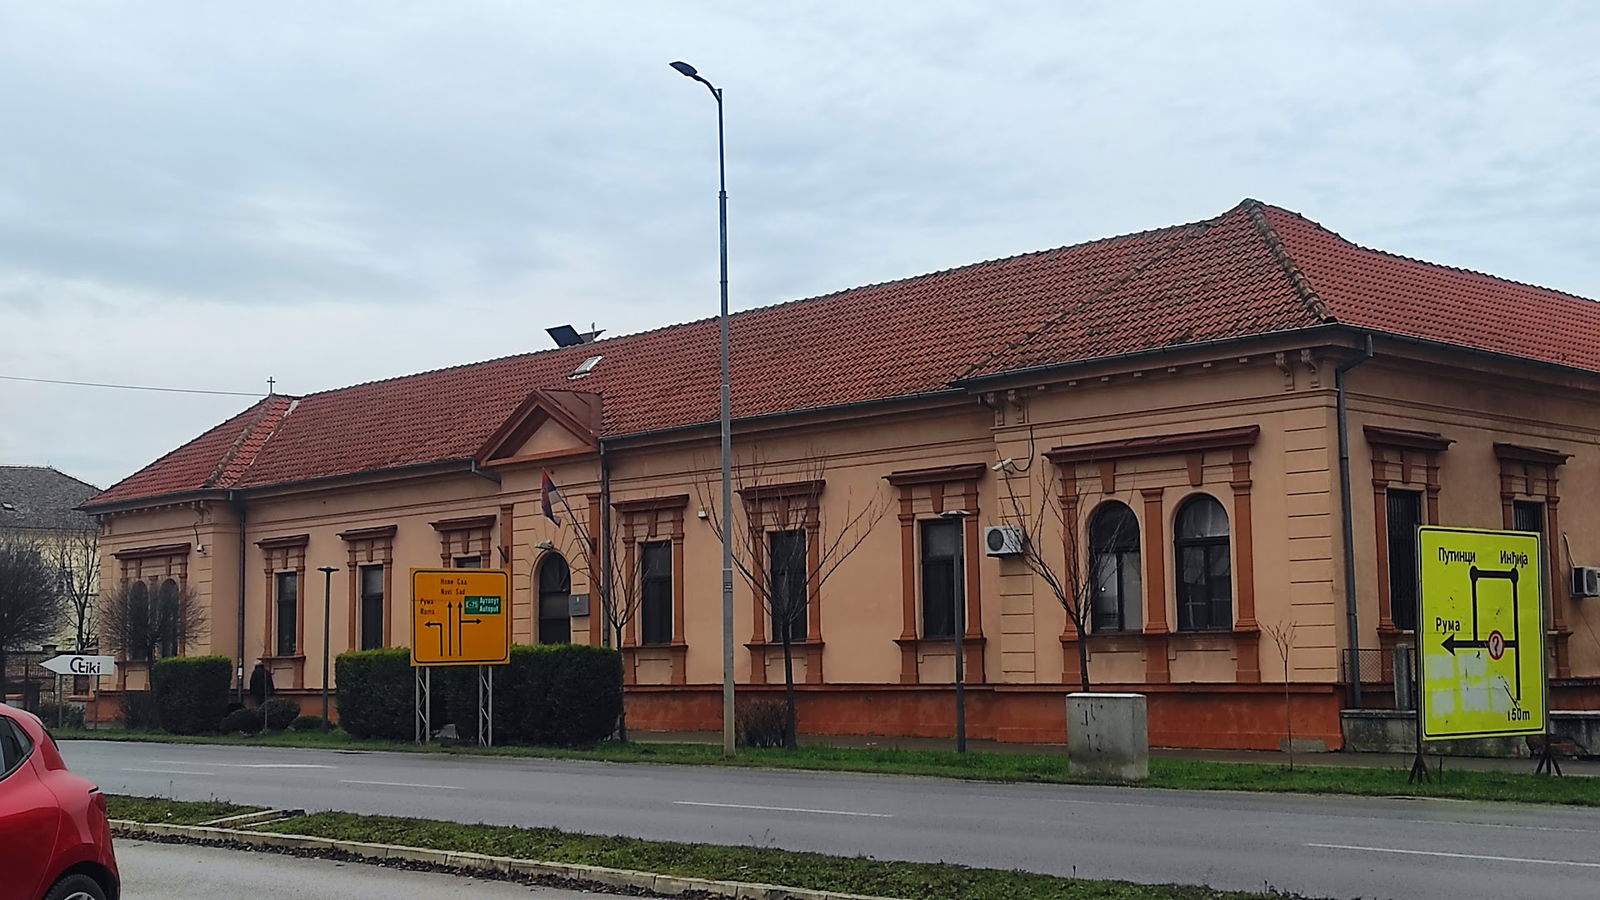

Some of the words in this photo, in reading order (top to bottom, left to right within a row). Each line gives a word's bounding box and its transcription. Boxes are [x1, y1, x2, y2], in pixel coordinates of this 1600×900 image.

[1438, 547, 1476, 565] Путинци
[1500, 550, 1528, 568] Инђија
[1435, 617, 1460, 635] Рума
